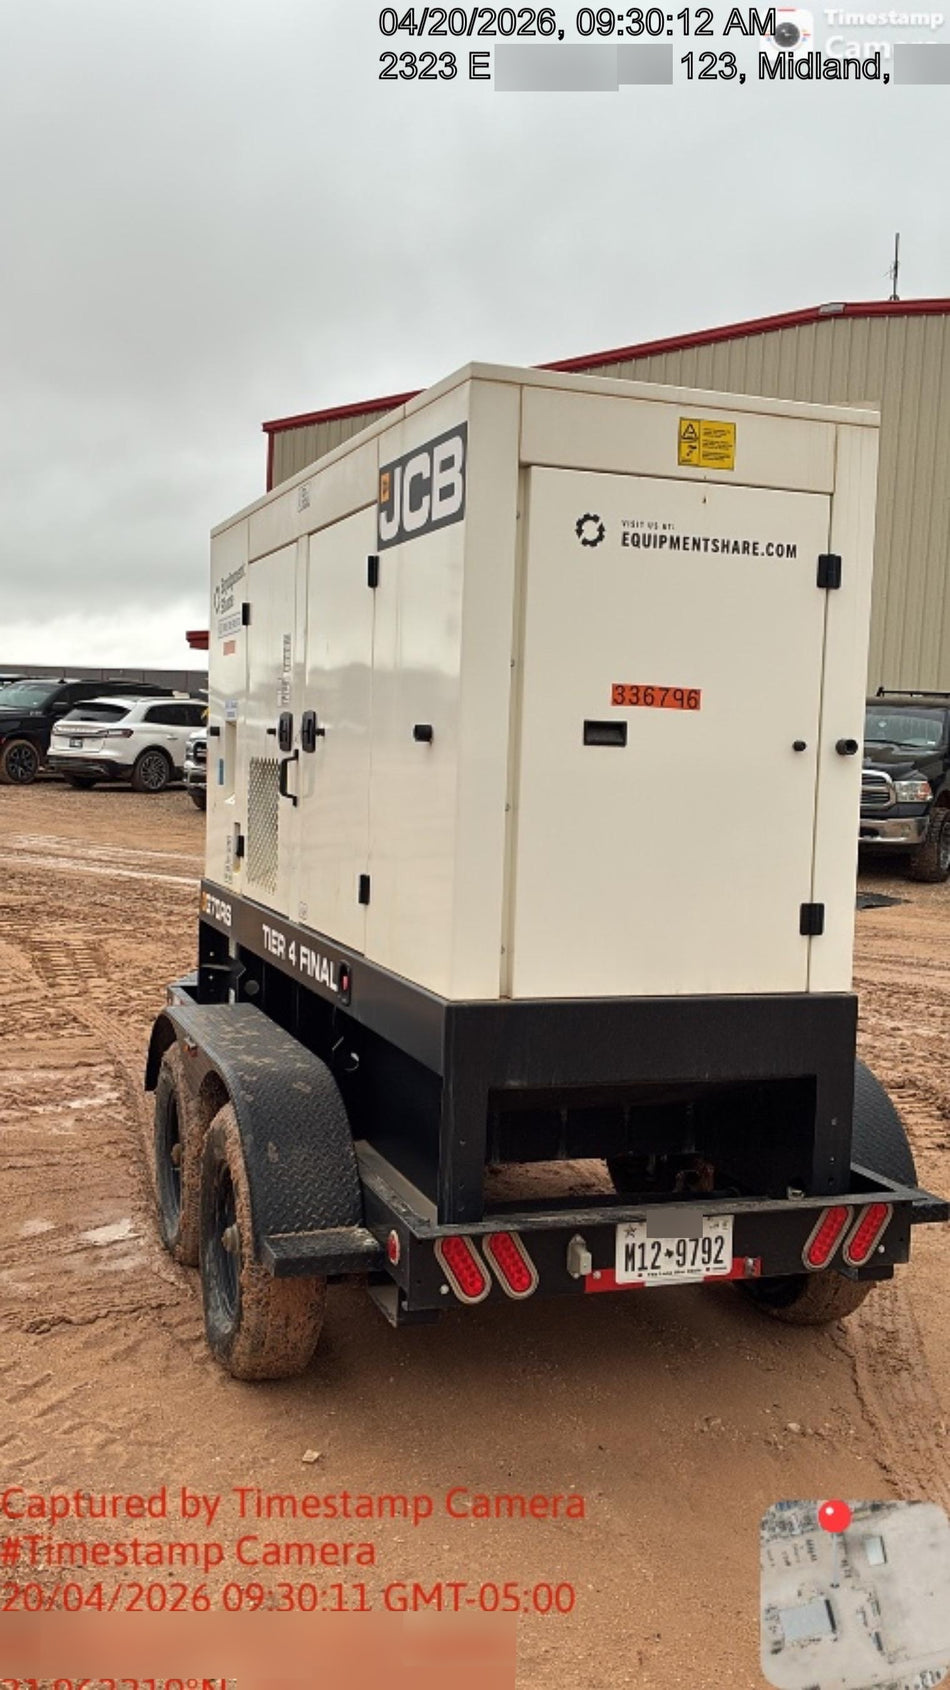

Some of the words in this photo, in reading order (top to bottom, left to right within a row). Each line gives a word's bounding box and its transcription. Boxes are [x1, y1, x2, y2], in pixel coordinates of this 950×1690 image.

[379, 435, 465, 542] JCB
[621, 519, 644, 528] VISIT
[647, 521, 658, 530] US
[621, 531, 797, 558] EQUIPMENTSHARE.COM
[613, 684, 698, 709] 336796
[262, 923, 286, 960] TIER
[289, 940, 297, 966] 4
[300, 945, 338, 992] FINAL
